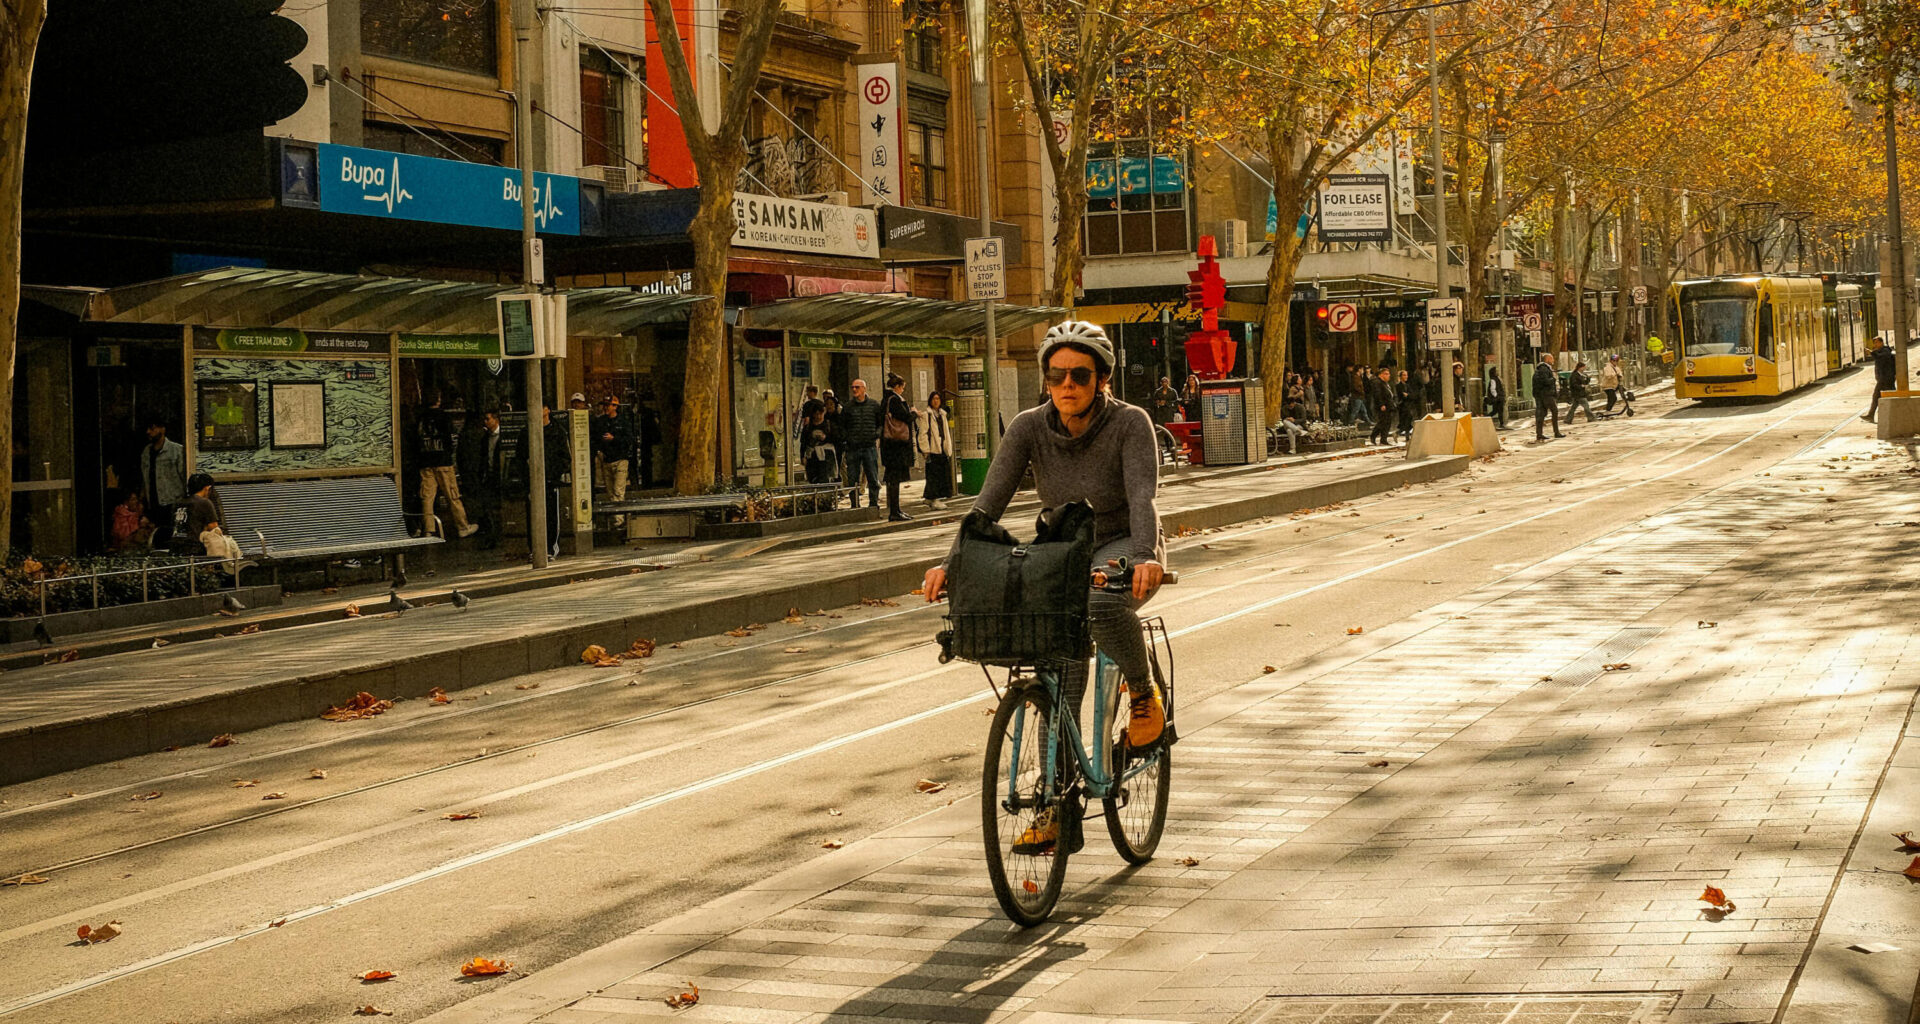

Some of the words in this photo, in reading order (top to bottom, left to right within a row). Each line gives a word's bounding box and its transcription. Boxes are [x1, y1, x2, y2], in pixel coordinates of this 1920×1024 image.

[341, 156, 385, 190] Bupa
[503, 177, 539, 207] Bua
[1324, 194, 1346, 204] FOR
[1349, 194, 1382, 204] LEASE
[736, 198, 746, 240] 삼삼
[748, 200, 824, 232] SAMSAM
[889, 220, 921, 240] SUPERHIRO
[969, 264, 1001, 272] CYCLISTS
[973, 281, 998, 289] BEHIND
[1431, 324, 1456, 335] ONLY
[238, 336, 254, 345] FREE
[255, 336, 272, 345] TRAM
[272, 337, 288, 346] ZONE
[315, 338, 328, 347] ends
[329, 339, 335, 347] at
[335, 339, 344, 348] the
[345, 339, 357, 348] next
[358, 339, 369, 349] stop
[398, 340, 417, 349] Bourke
[417, 340, 433, 349] Street
[464, 341, 479, 350] Street
[1435, 340, 1454, 348] END
[1735, 346, 1753, 354] 3530
